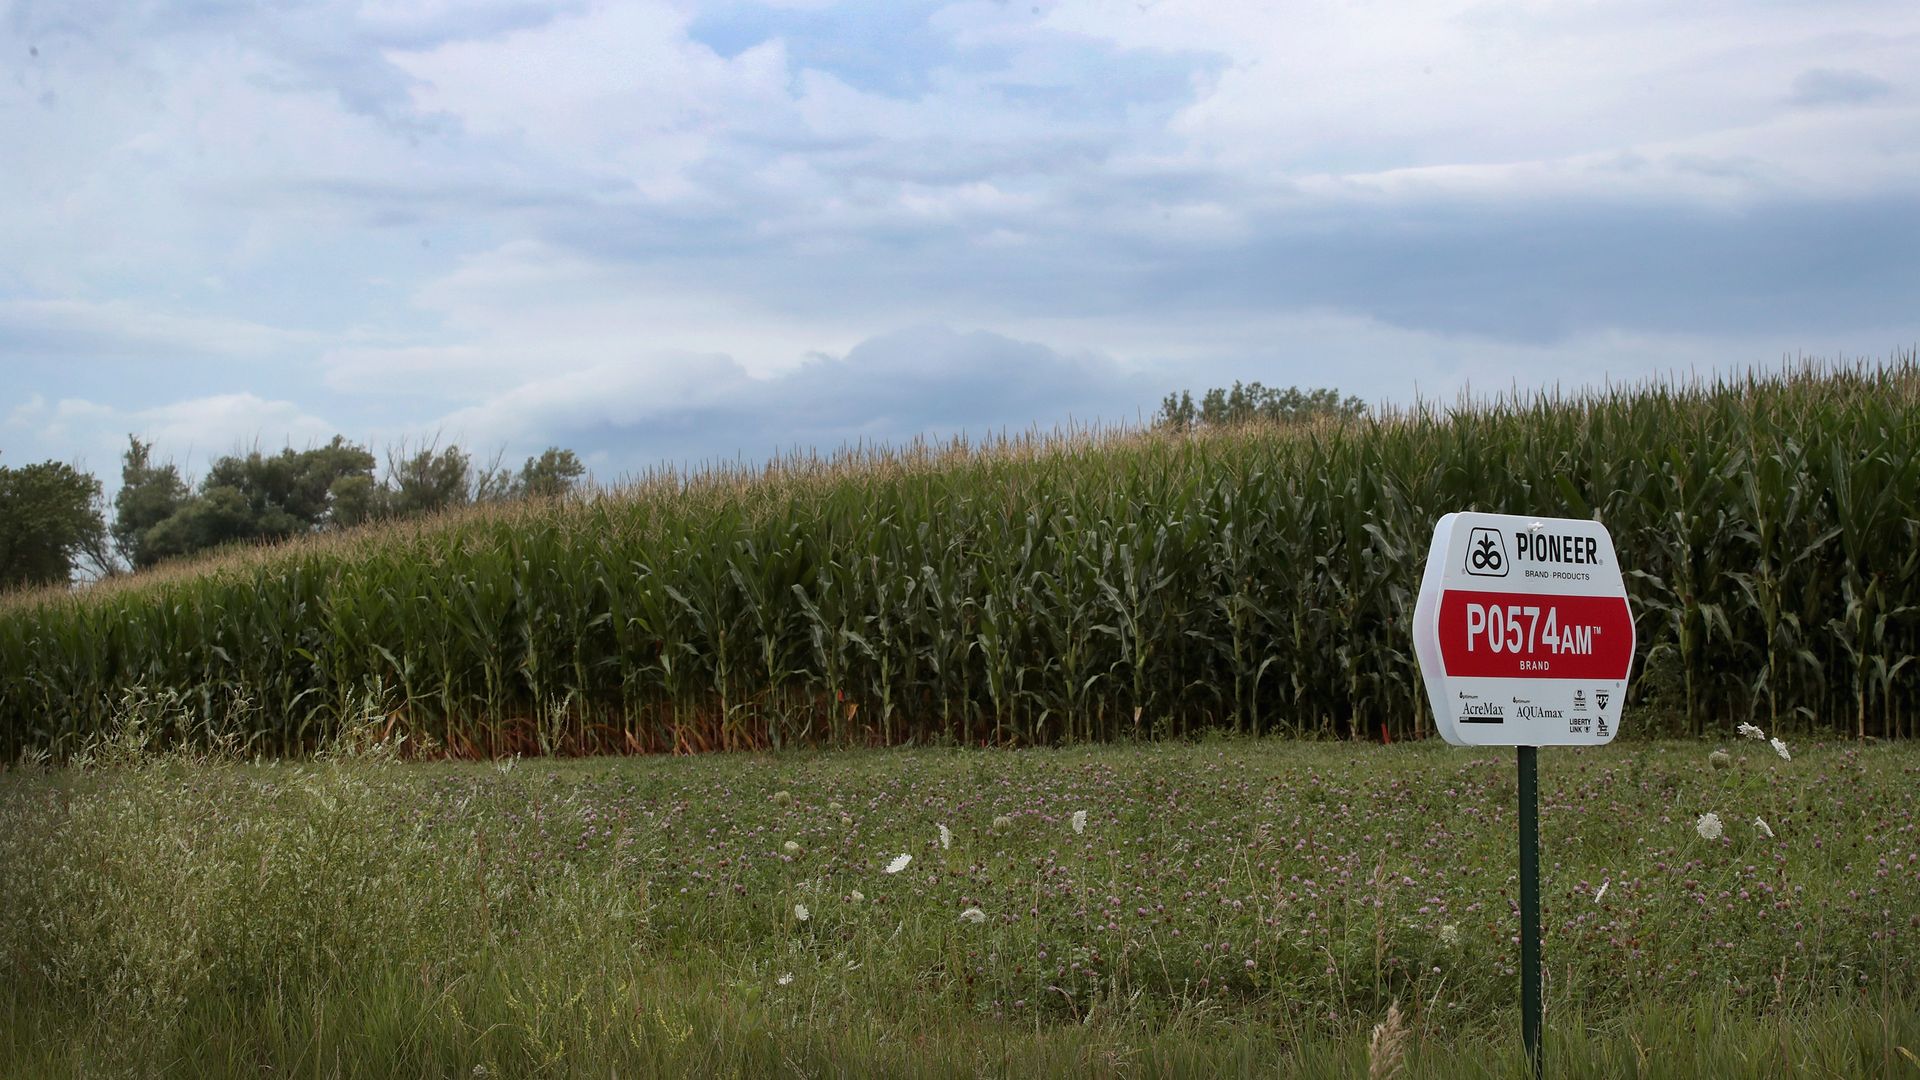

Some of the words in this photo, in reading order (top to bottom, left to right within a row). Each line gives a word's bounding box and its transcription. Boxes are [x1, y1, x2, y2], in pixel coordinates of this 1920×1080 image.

[1516, 532, 1598, 565] PIONEER
[1525, 570, 1549, 579] BRAND
[1552, 571, 1590, 581] PRODUCTS
[1519, 660, 1550, 671] BRAND
[1462, 702, 1504, 715] AcreMax
[1516, 706, 1563, 720] AQUAmax
[1569, 718, 1591, 726] LIBERTY
